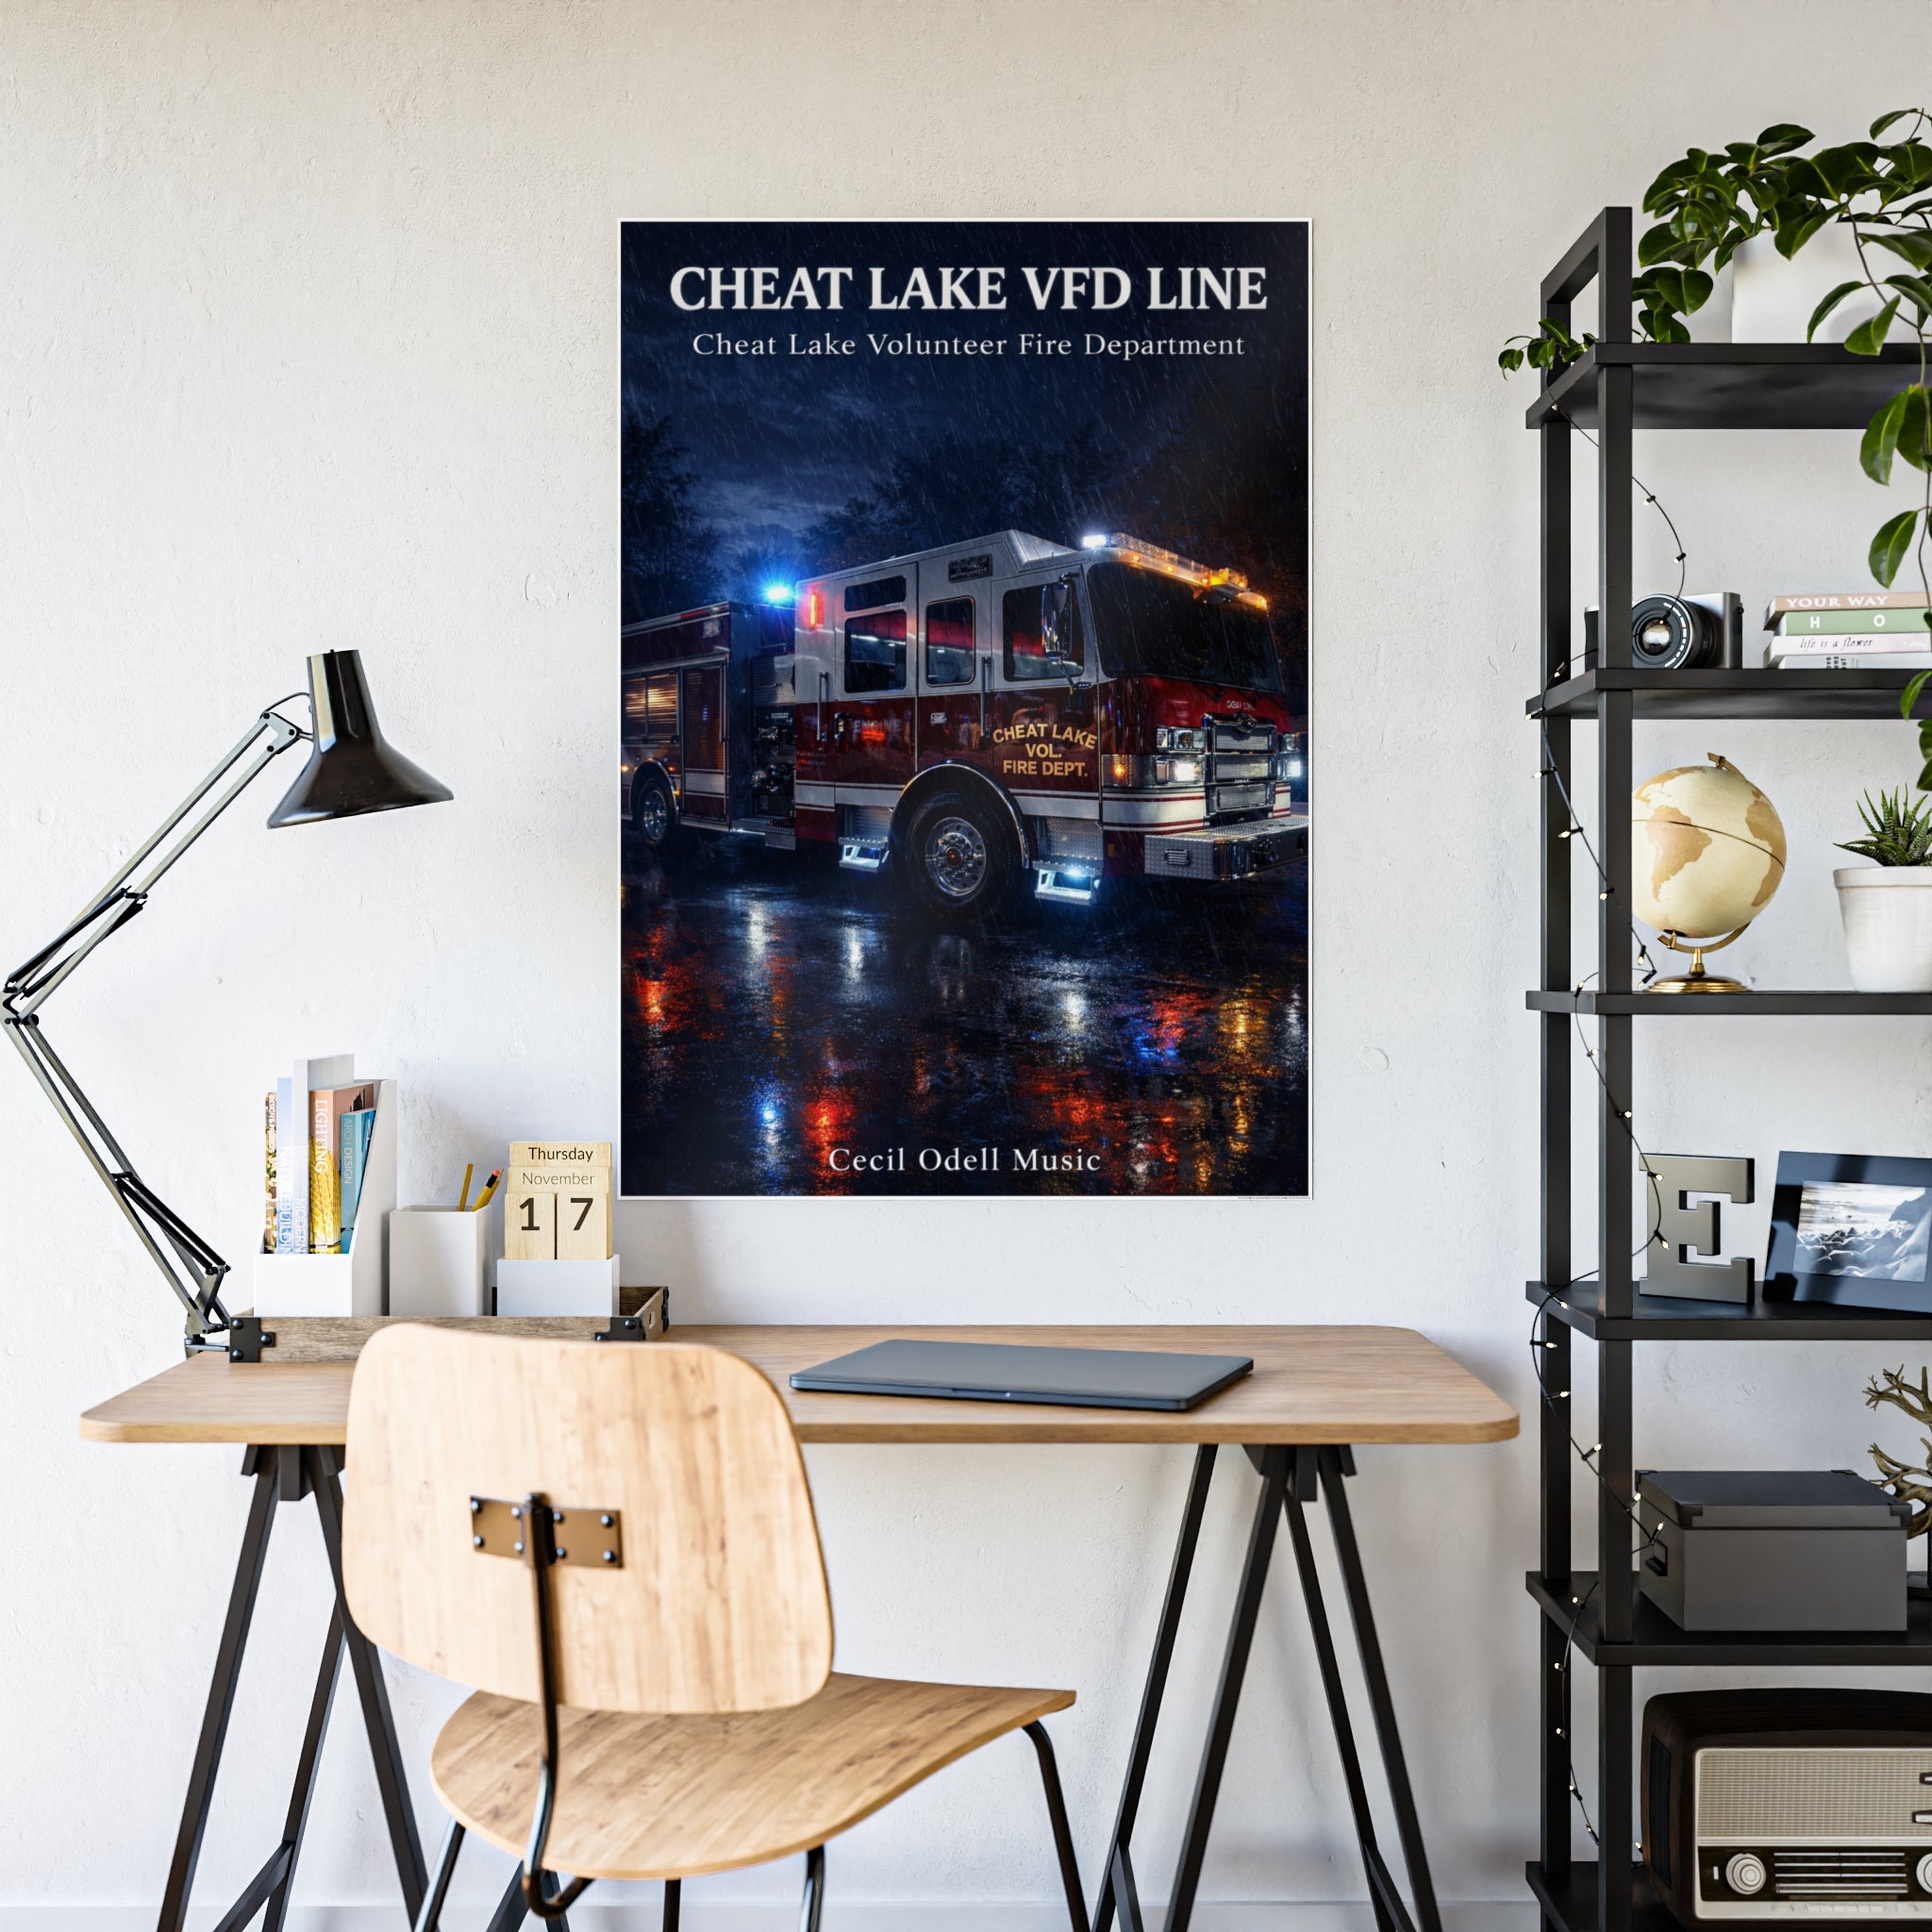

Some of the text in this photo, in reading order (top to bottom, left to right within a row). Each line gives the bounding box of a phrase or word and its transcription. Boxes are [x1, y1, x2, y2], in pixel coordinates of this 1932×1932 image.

[670, 266, 1268, 310] CHEAT LAKE VFD LINE
[692, 333, 1245, 360] Cheat Lake Volunteer Fire Department
[1787, 595, 1888, 608] YOUR WAY
[1800, 638, 1816, 652] life
[1840, 637, 1874, 651] flower
[992, 724, 1098, 750] CHEAT LAKE
[1025, 743, 1062, 758] VOL.
[1003, 759, 1088, 776] FIRE DEPT.
[315, 1099, 328, 1174] LIGHTING
[528, 1147, 593, 1162] Thursday
[829, 1147, 1101, 1172] Cecil Odell Music
[523, 1172, 594, 1185] November
[1640, 1153, 1755, 1306] E
